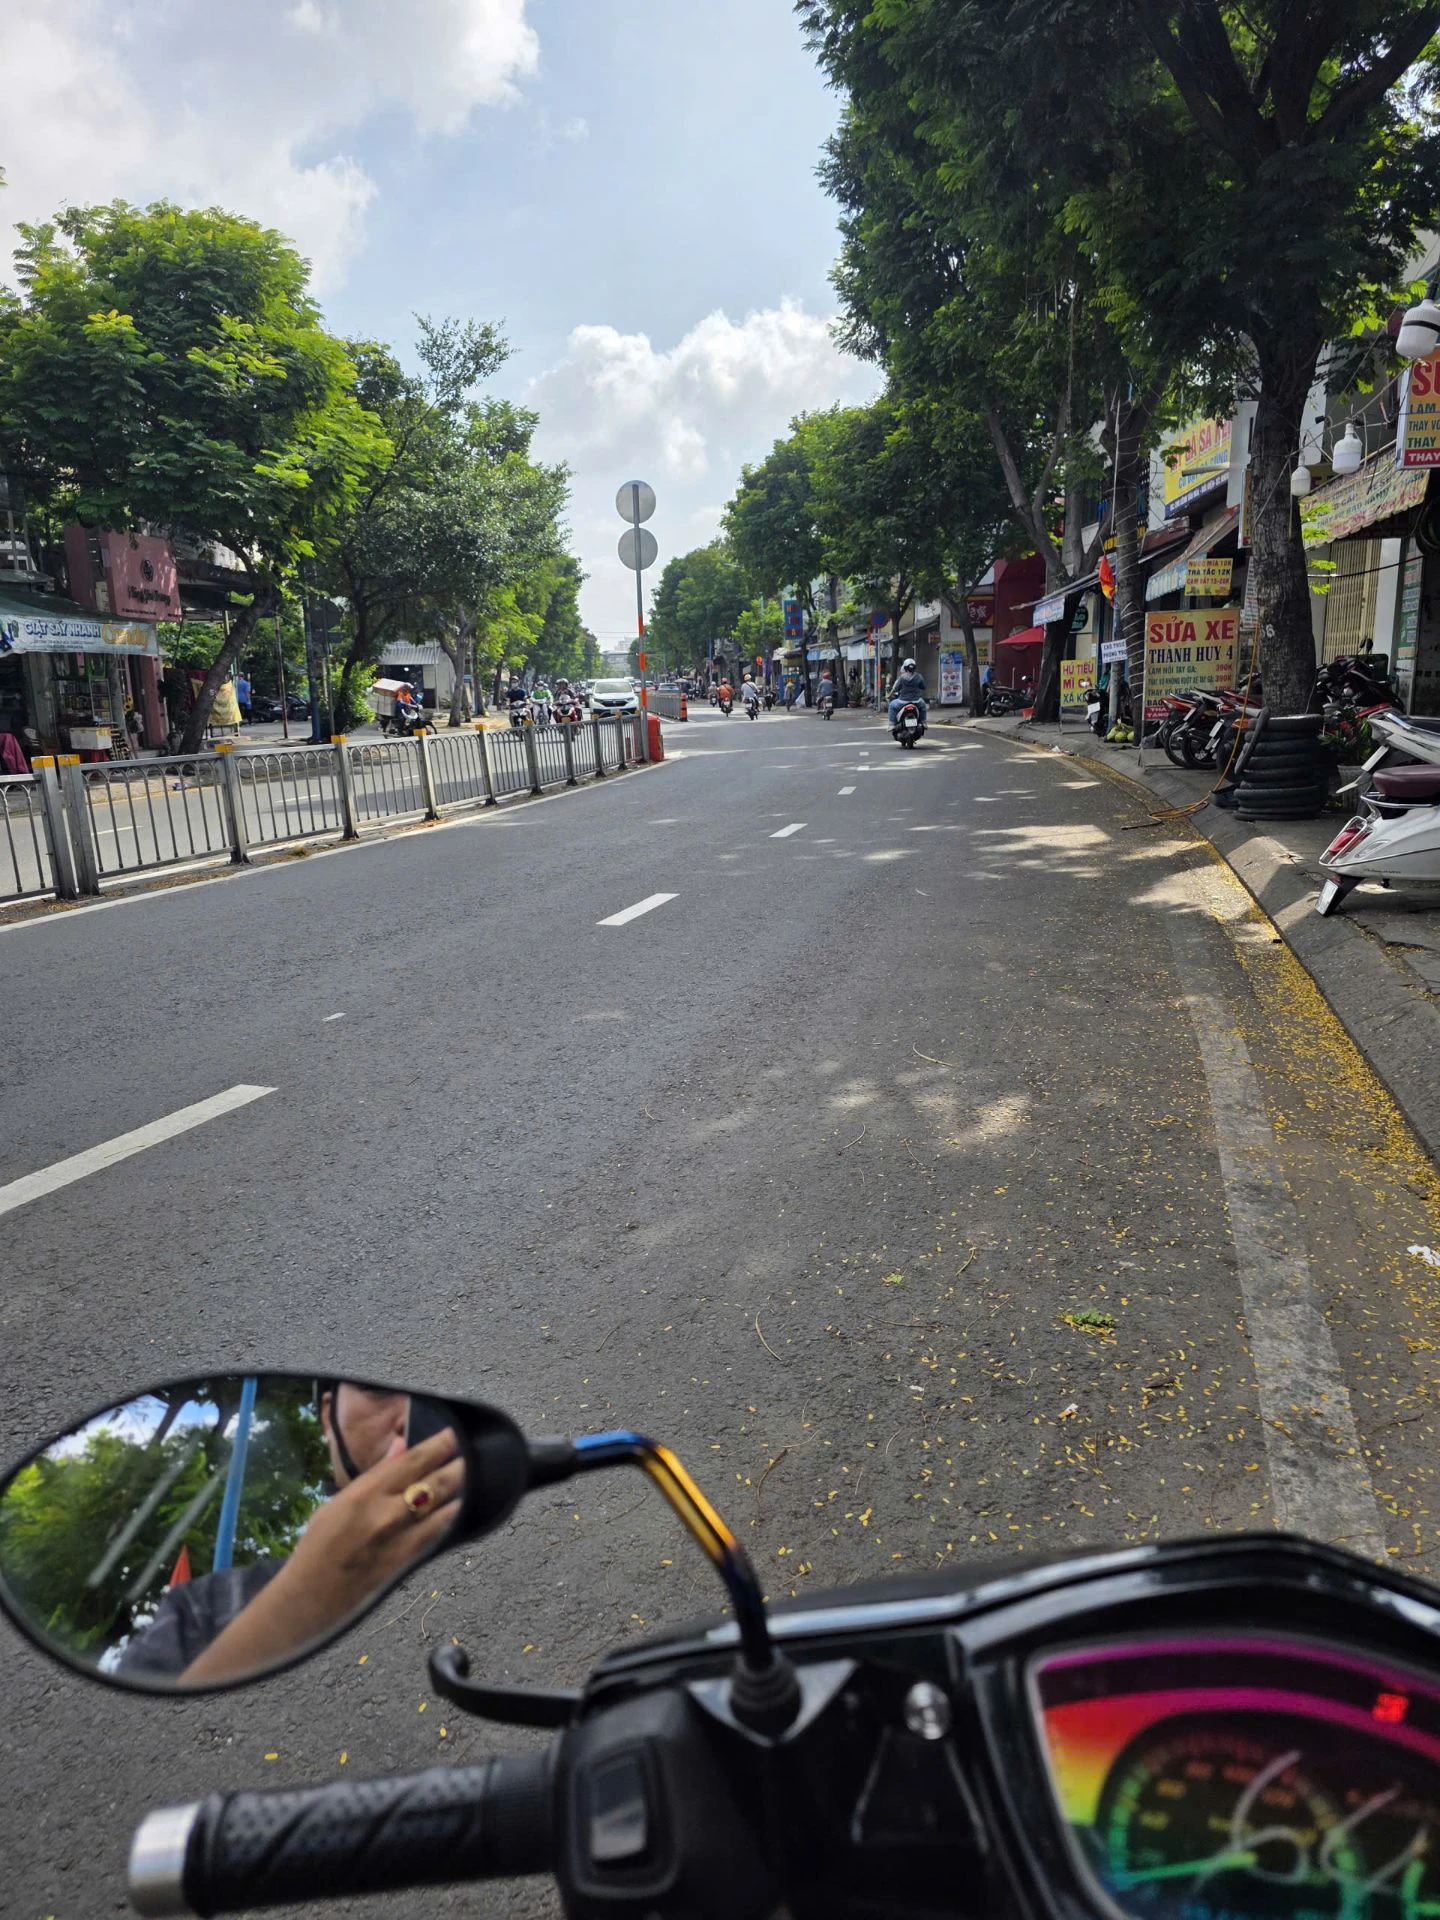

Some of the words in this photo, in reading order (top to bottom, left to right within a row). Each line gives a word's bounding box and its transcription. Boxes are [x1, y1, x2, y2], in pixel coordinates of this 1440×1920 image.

[1409, 420, 1429, 432] THAY
[1408, 437, 1436, 449] THAY
[1408, 452, 1440, 463] THAY
[69, 622, 101, 638] NHANH
[1149, 615, 1197, 644] SỬA
[1205, 619, 1235, 641] XE
[1149, 646, 1191, 664] THÀNH
[1196, 645, 1222, 662] HUY
[1226, 645, 1233, 660] 4
